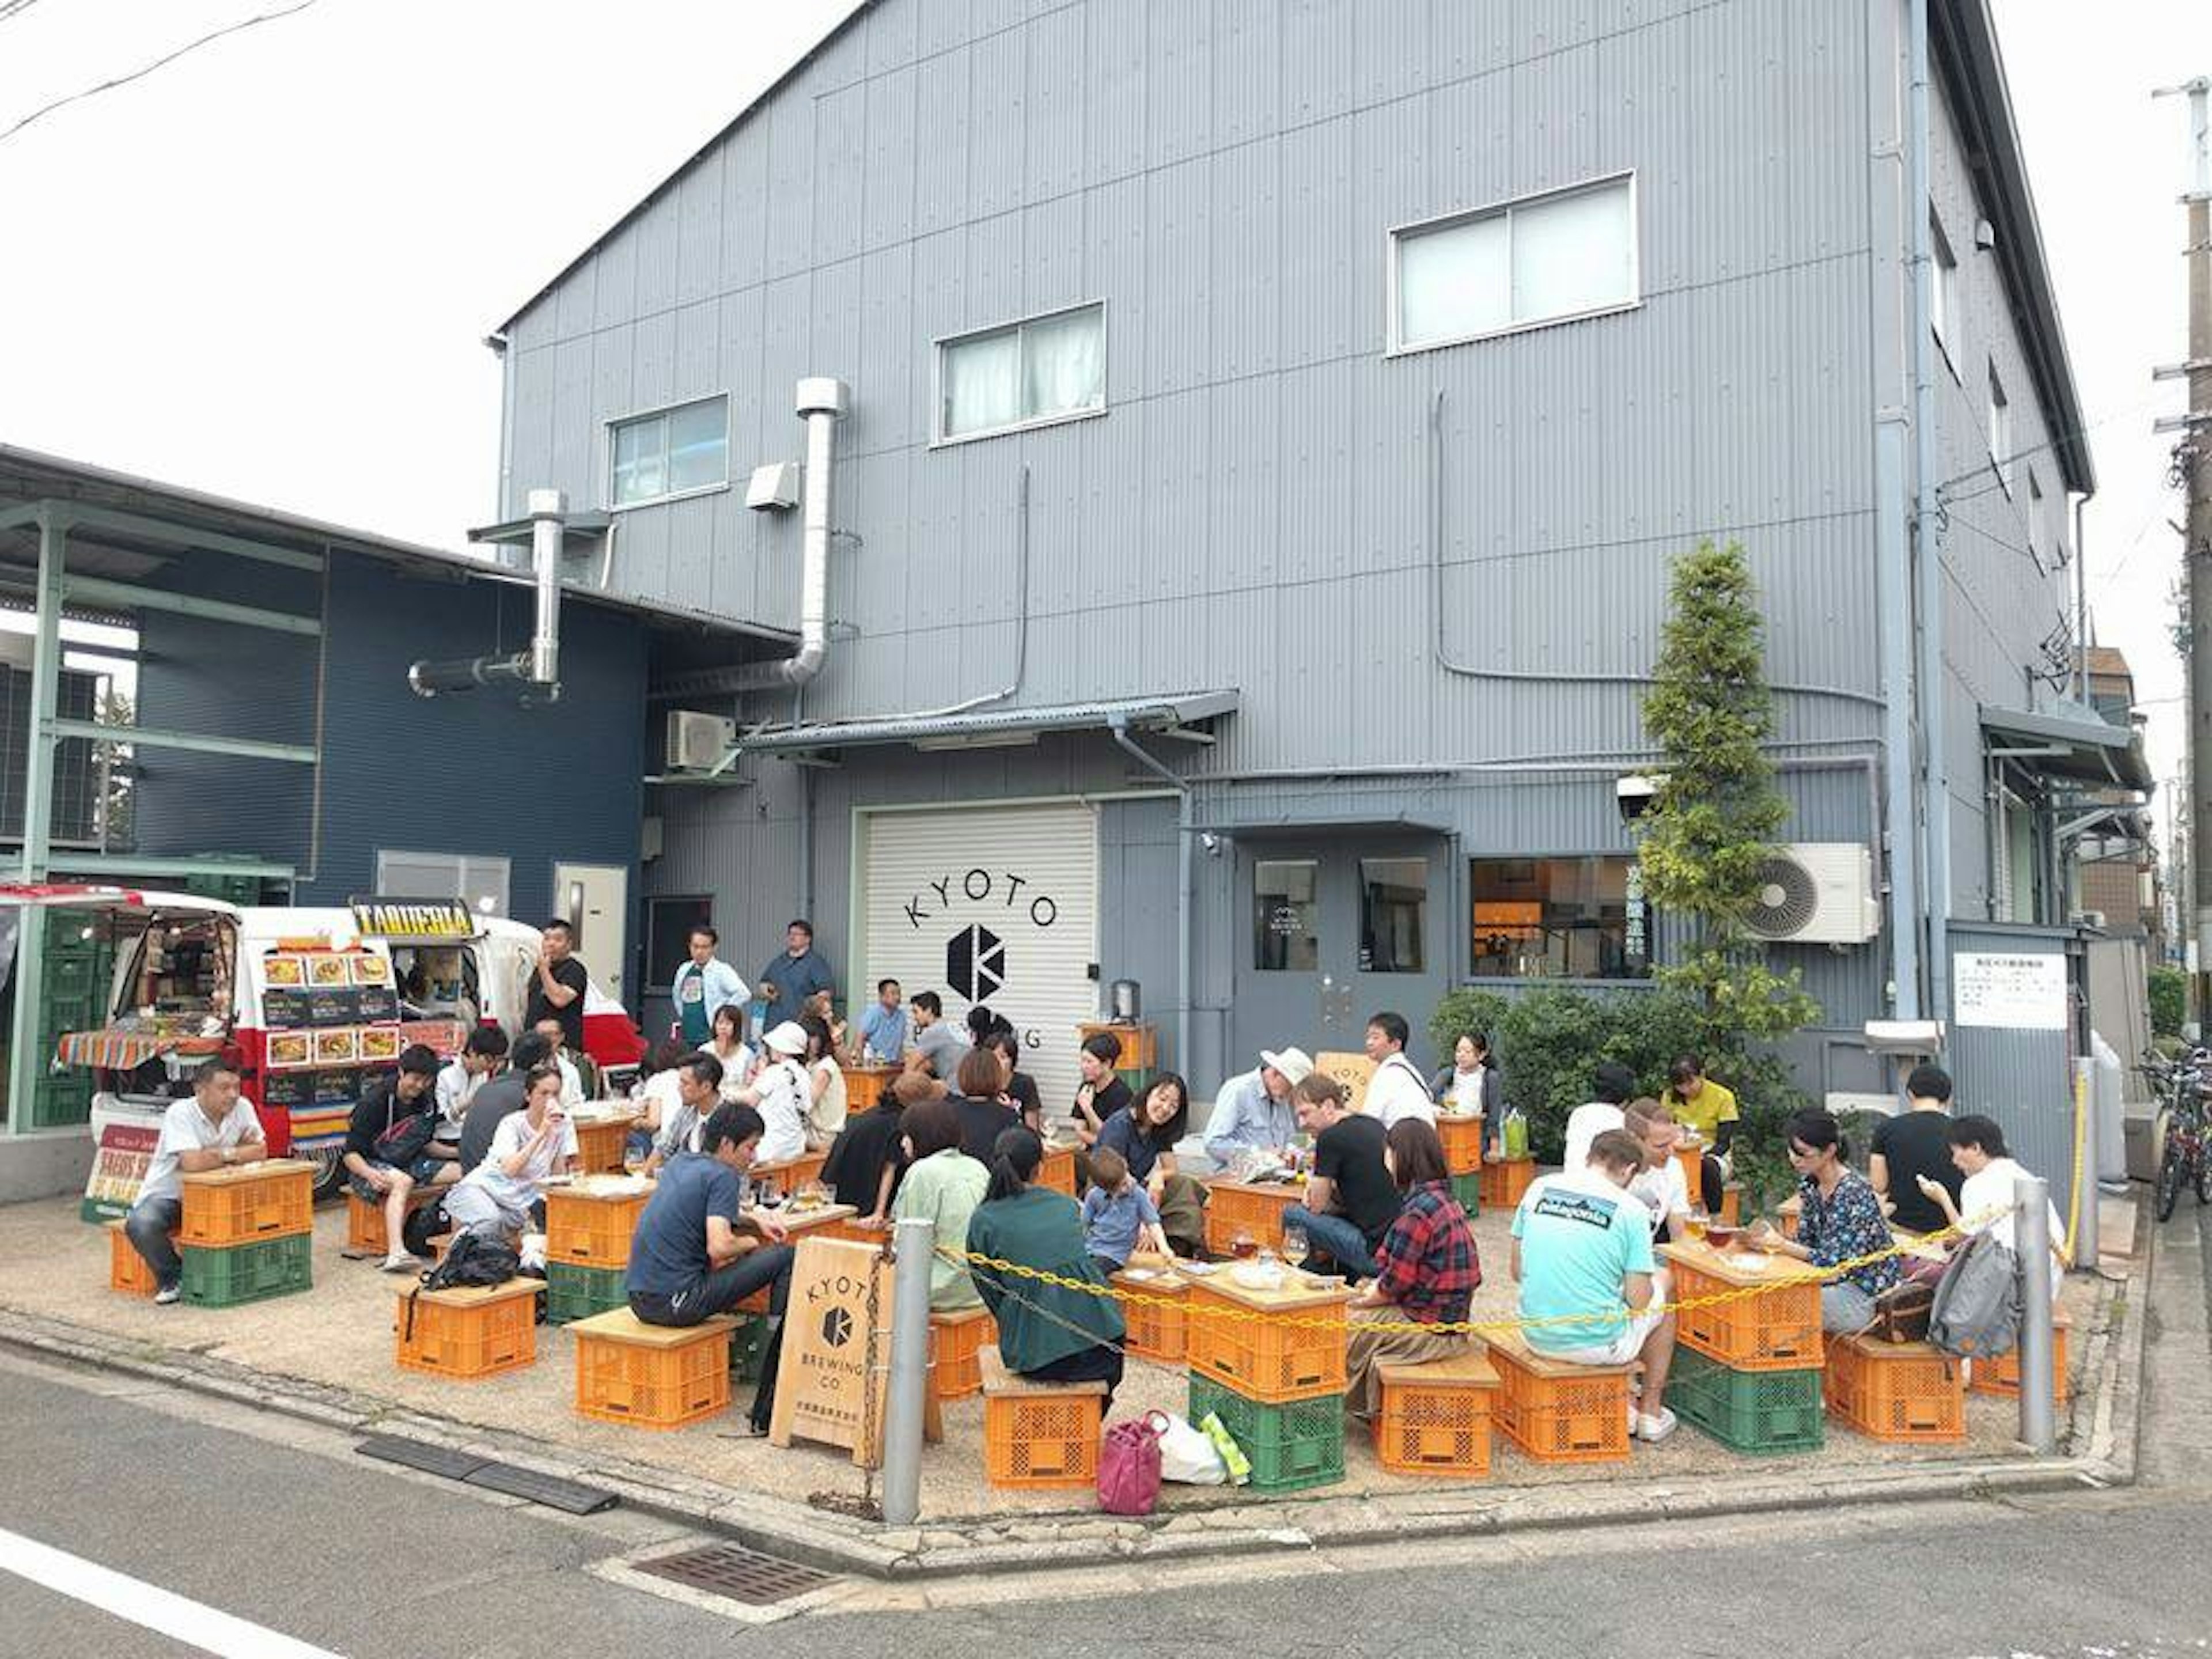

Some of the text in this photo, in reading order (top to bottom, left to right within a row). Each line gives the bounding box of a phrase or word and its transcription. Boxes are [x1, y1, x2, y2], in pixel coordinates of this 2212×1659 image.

[904, 869, 1056, 928] KYOTO
[1332, 1068, 1367, 1086] YOTO
[806, 1276, 877, 1315] KYOT
[801, 1353, 863, 1376] BREWING
